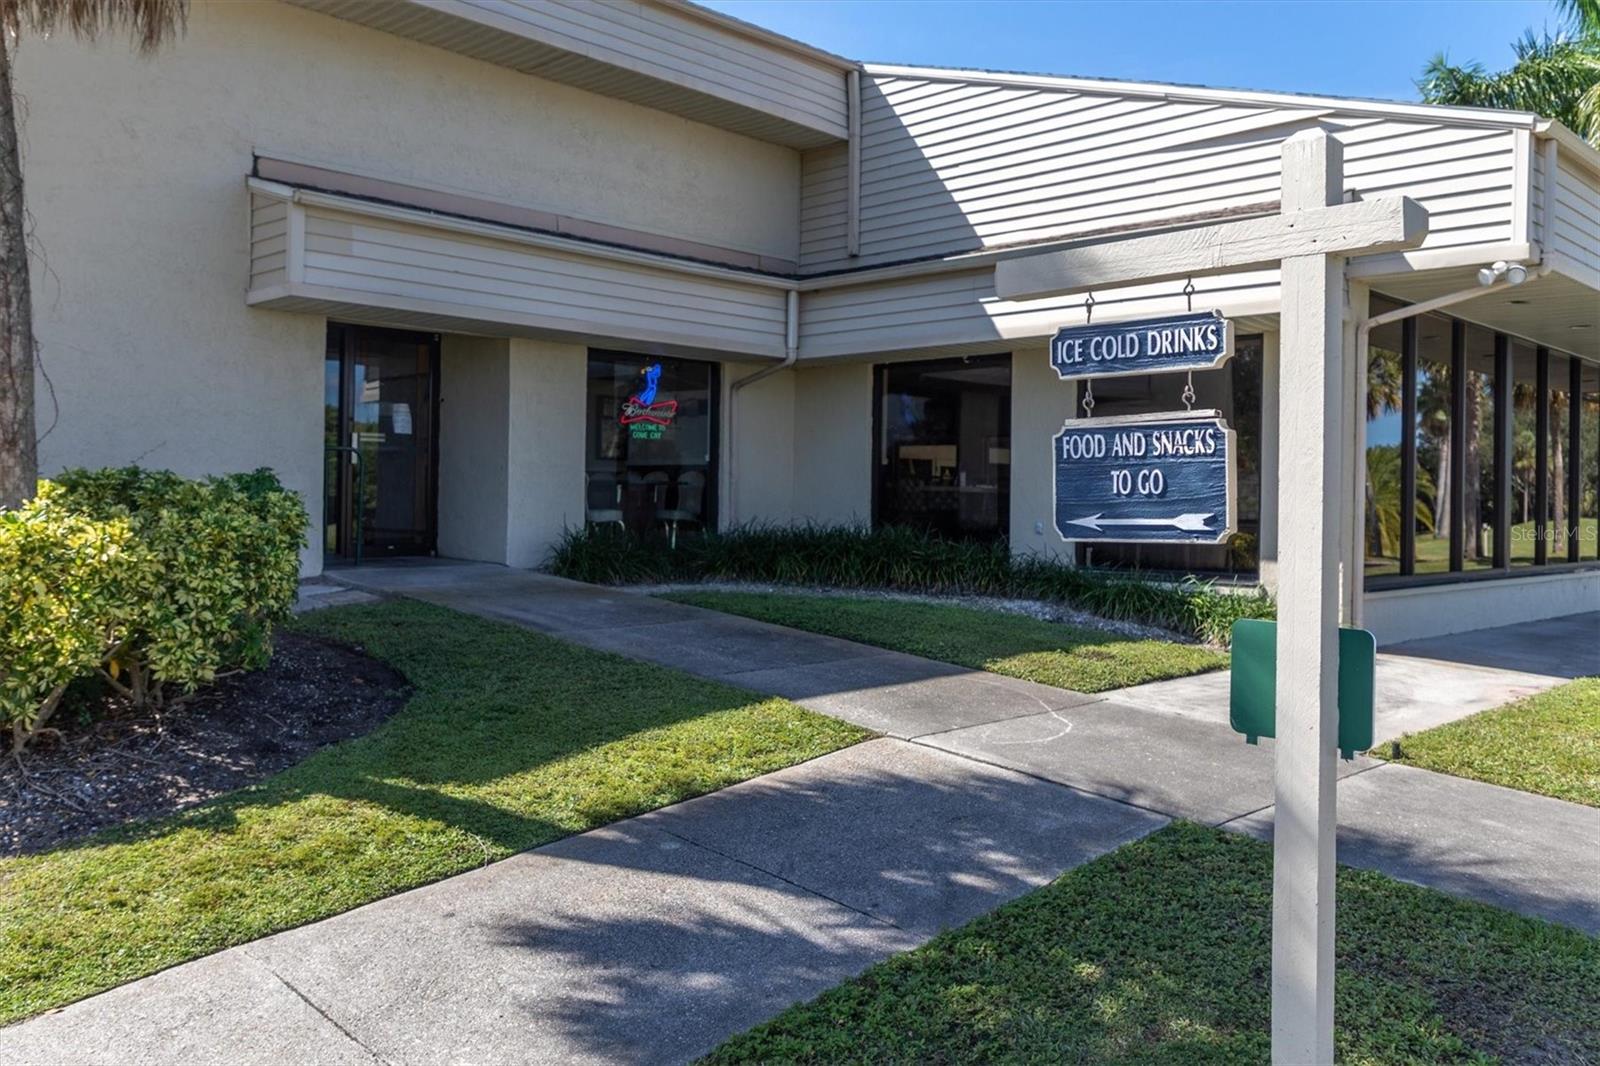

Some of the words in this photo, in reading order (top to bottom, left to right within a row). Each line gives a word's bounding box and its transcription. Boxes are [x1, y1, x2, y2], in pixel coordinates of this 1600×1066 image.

[1057, 339, 1083, 364] ICE
[1090, 333, 1139, 361] COLD
[1147, 325, 1218, 356] DRINKS
[1062, 434, 1106, 459] FOOD
[1112, 432, 1146, 457] AND
[1152, 429, 1215, 456] SNACKS
[1111, 469, 1132, 495] TO
[1137, 469, 1164, 495] GO
